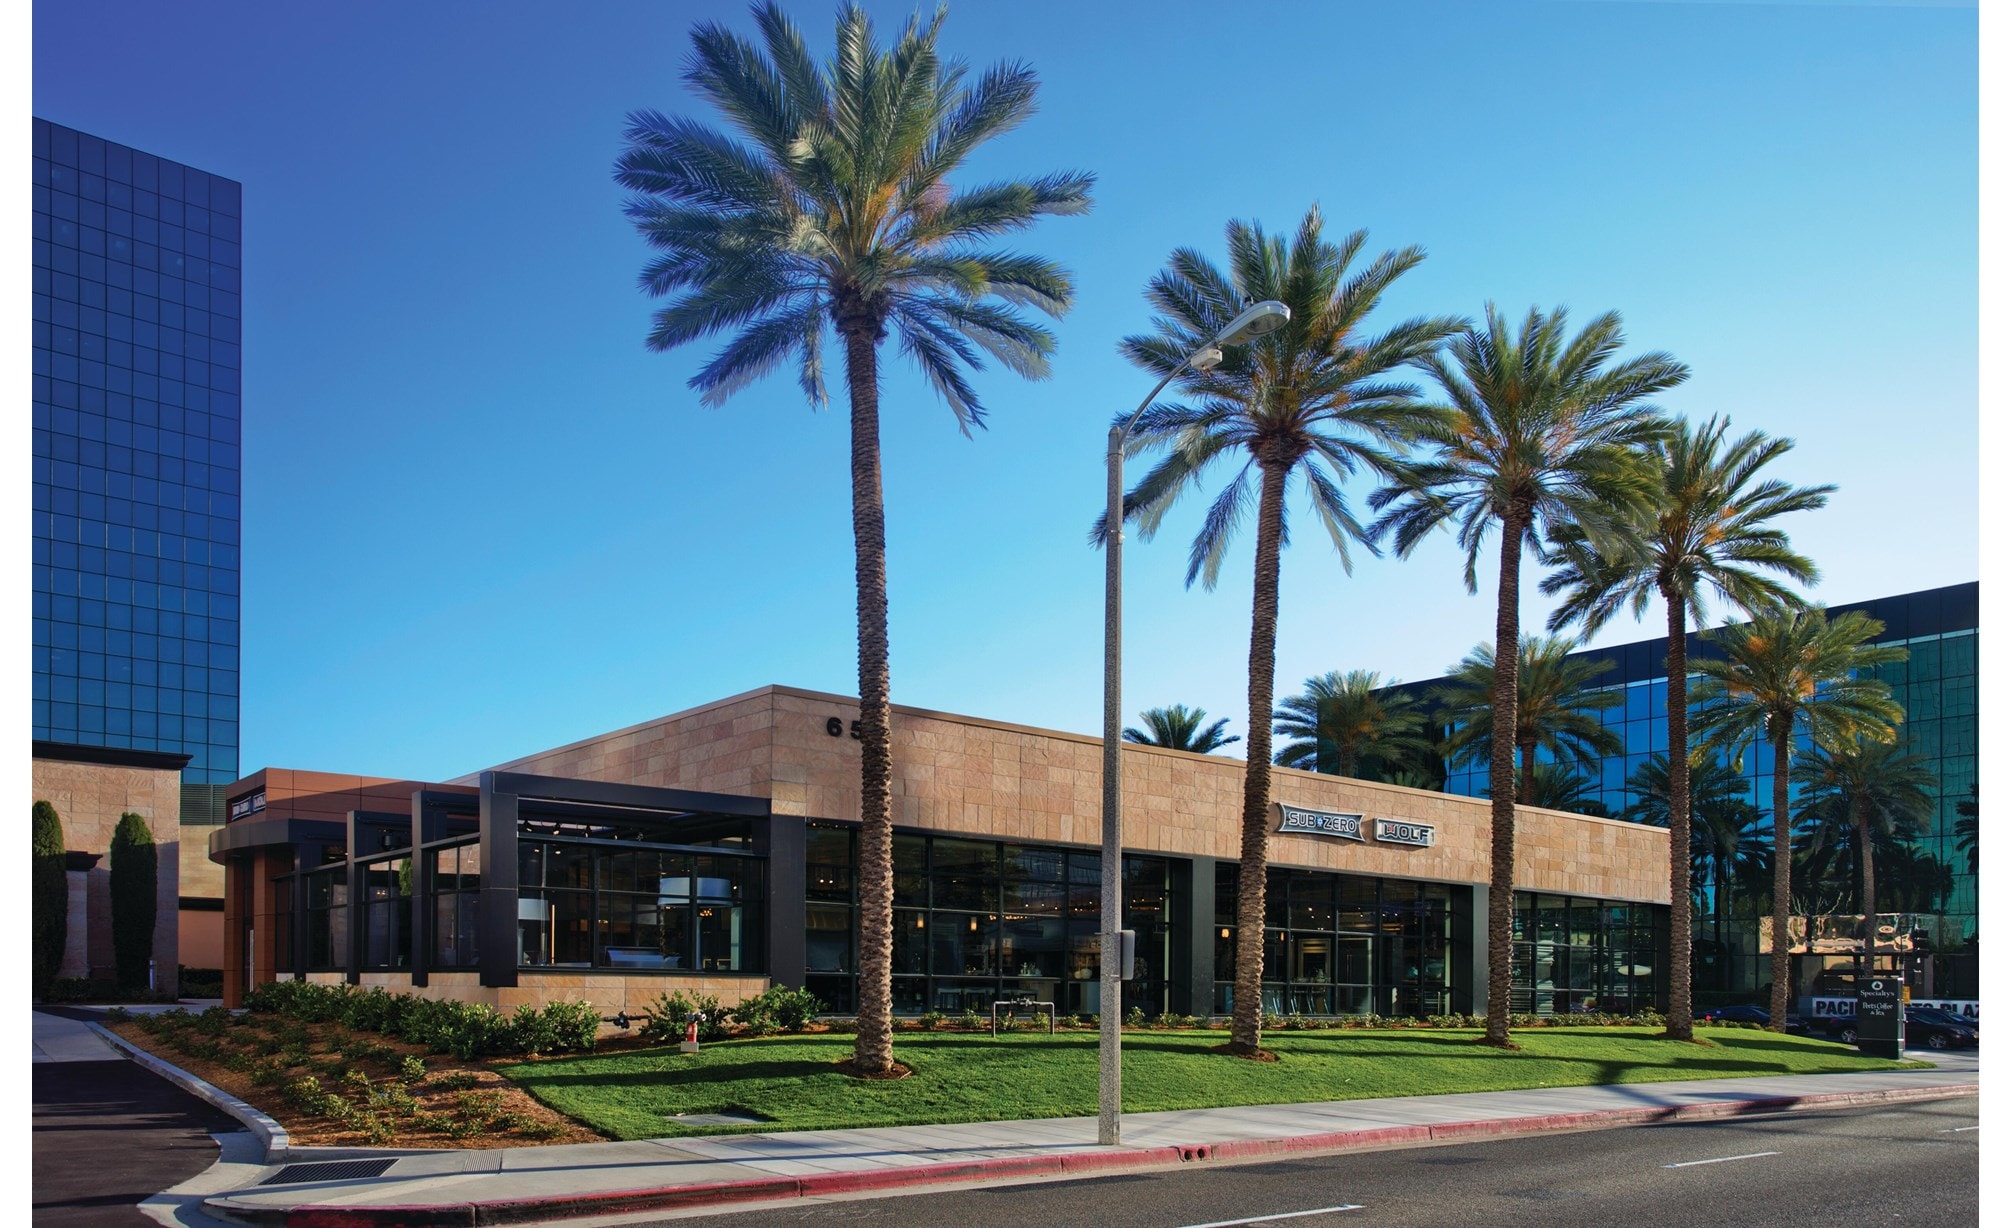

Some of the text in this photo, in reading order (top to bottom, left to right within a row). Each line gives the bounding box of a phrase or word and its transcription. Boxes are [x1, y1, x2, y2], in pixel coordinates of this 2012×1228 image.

[1288, 812, 1356, 833] SUB ZERO
[1384, 822, 1429, 841] WOLF
